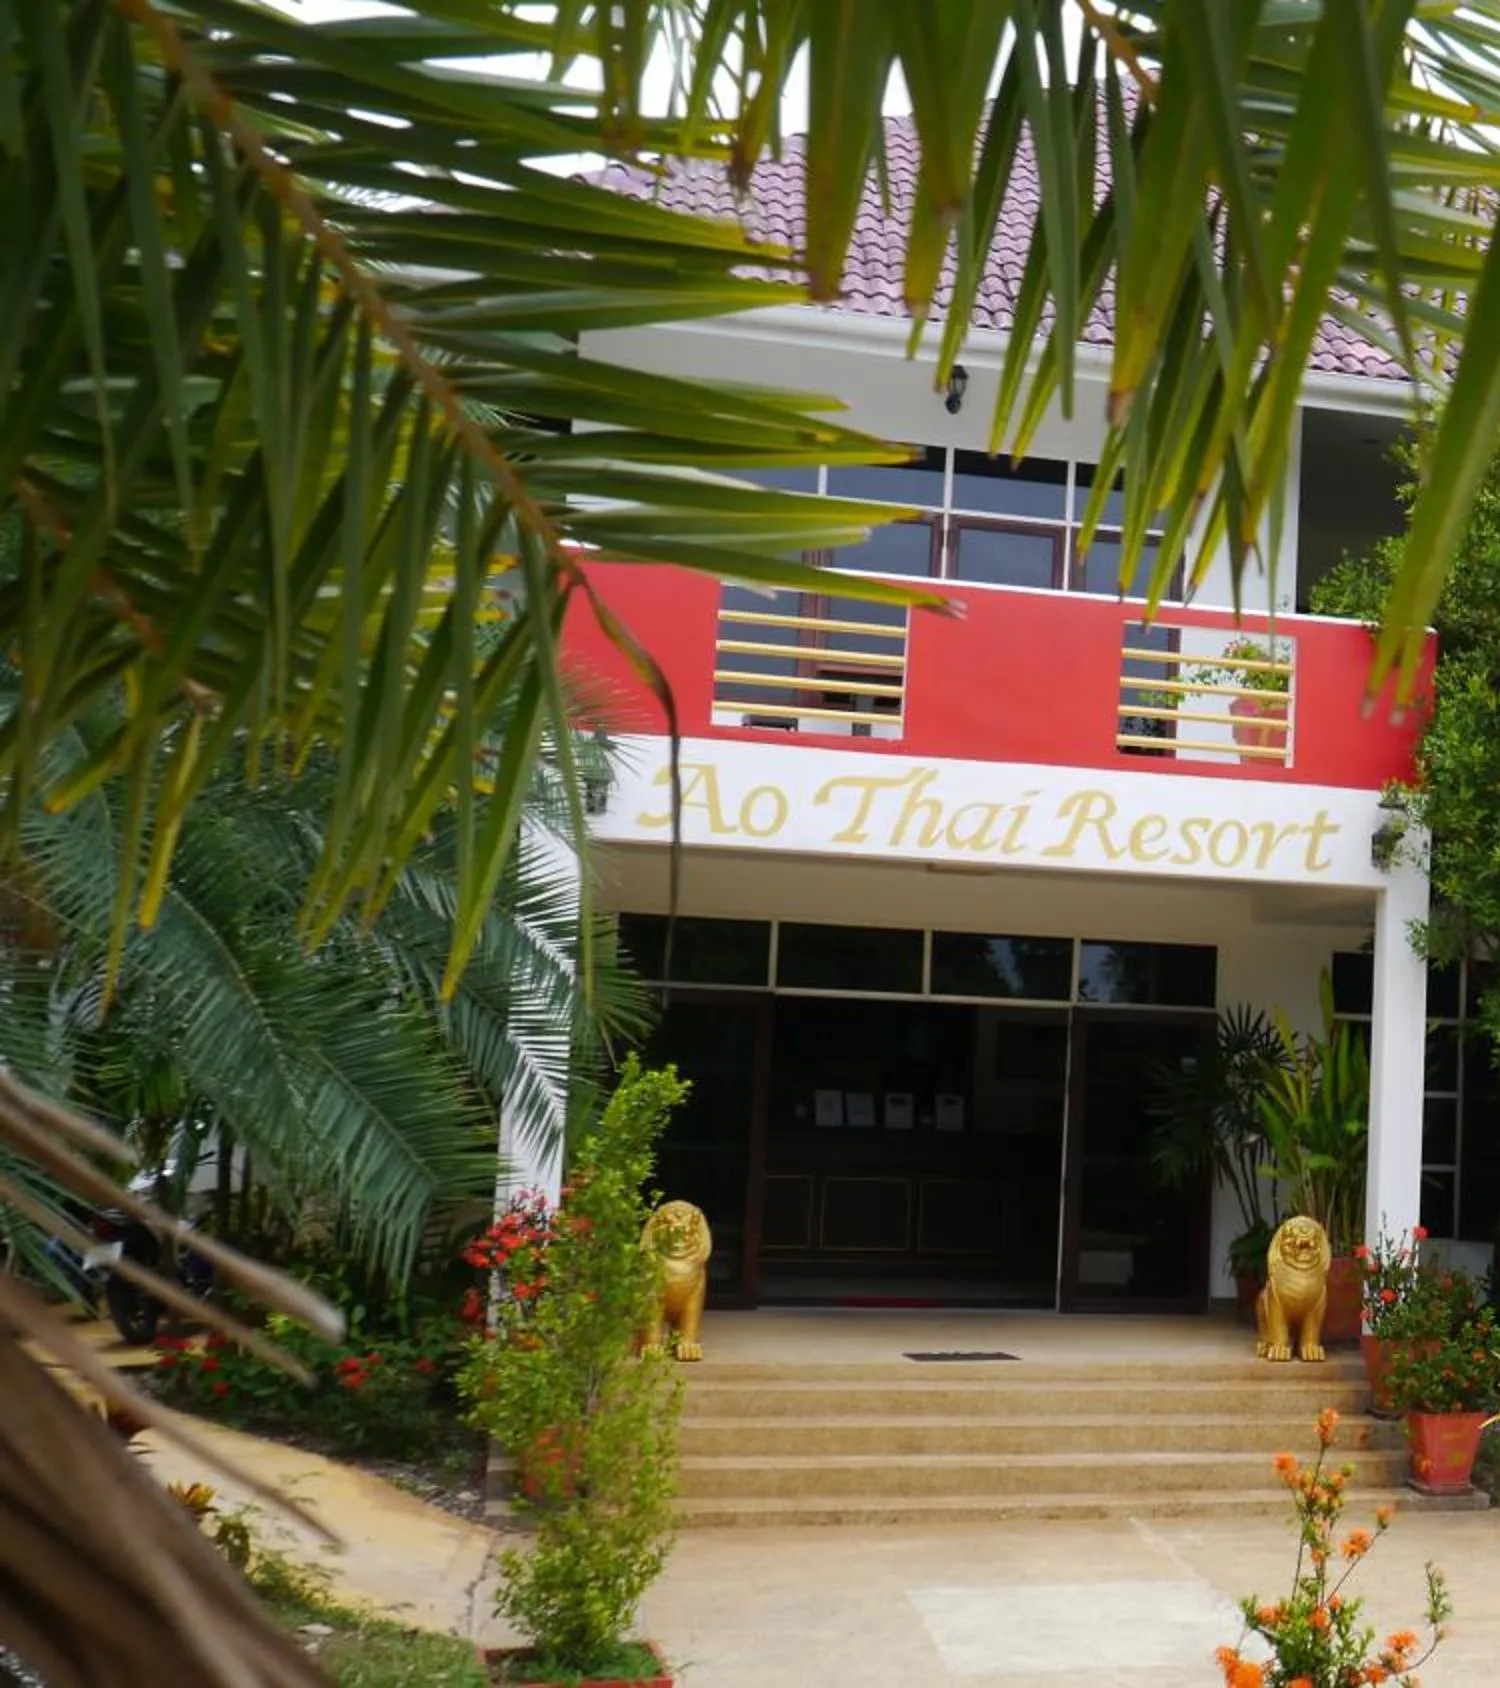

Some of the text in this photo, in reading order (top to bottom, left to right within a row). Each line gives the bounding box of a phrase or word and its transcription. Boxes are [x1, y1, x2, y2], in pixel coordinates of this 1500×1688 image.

[636, 763, 1340, 873] Ao Thai Resort
